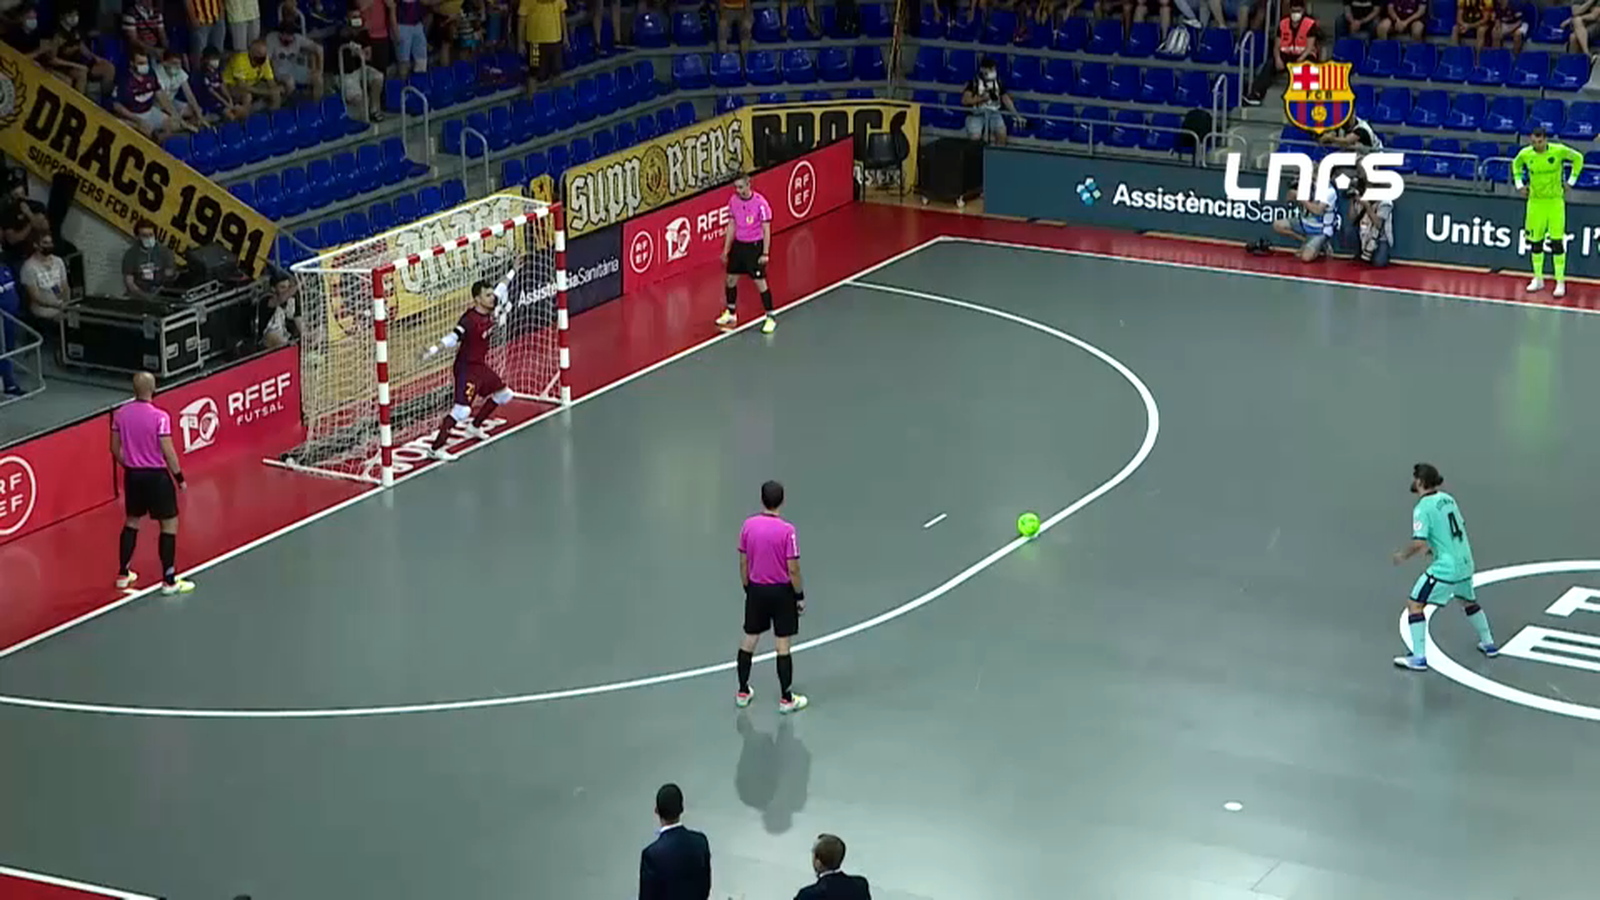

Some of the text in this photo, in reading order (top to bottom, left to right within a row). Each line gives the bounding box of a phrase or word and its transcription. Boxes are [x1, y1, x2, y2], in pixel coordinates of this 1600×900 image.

[23, 85, 264, 277] DRACS 1991
[105, 193, 130, 219] FCB
[697, 200, 730, 234] RFE
[702, 226, 729, 242] FUTS
[1425, 213, 1512, 248] Units
[228, 372, 291, 415] RFEF
[236, 401, 285, 426] FUTSAL
[1447, 511, 1464, 542] 4
